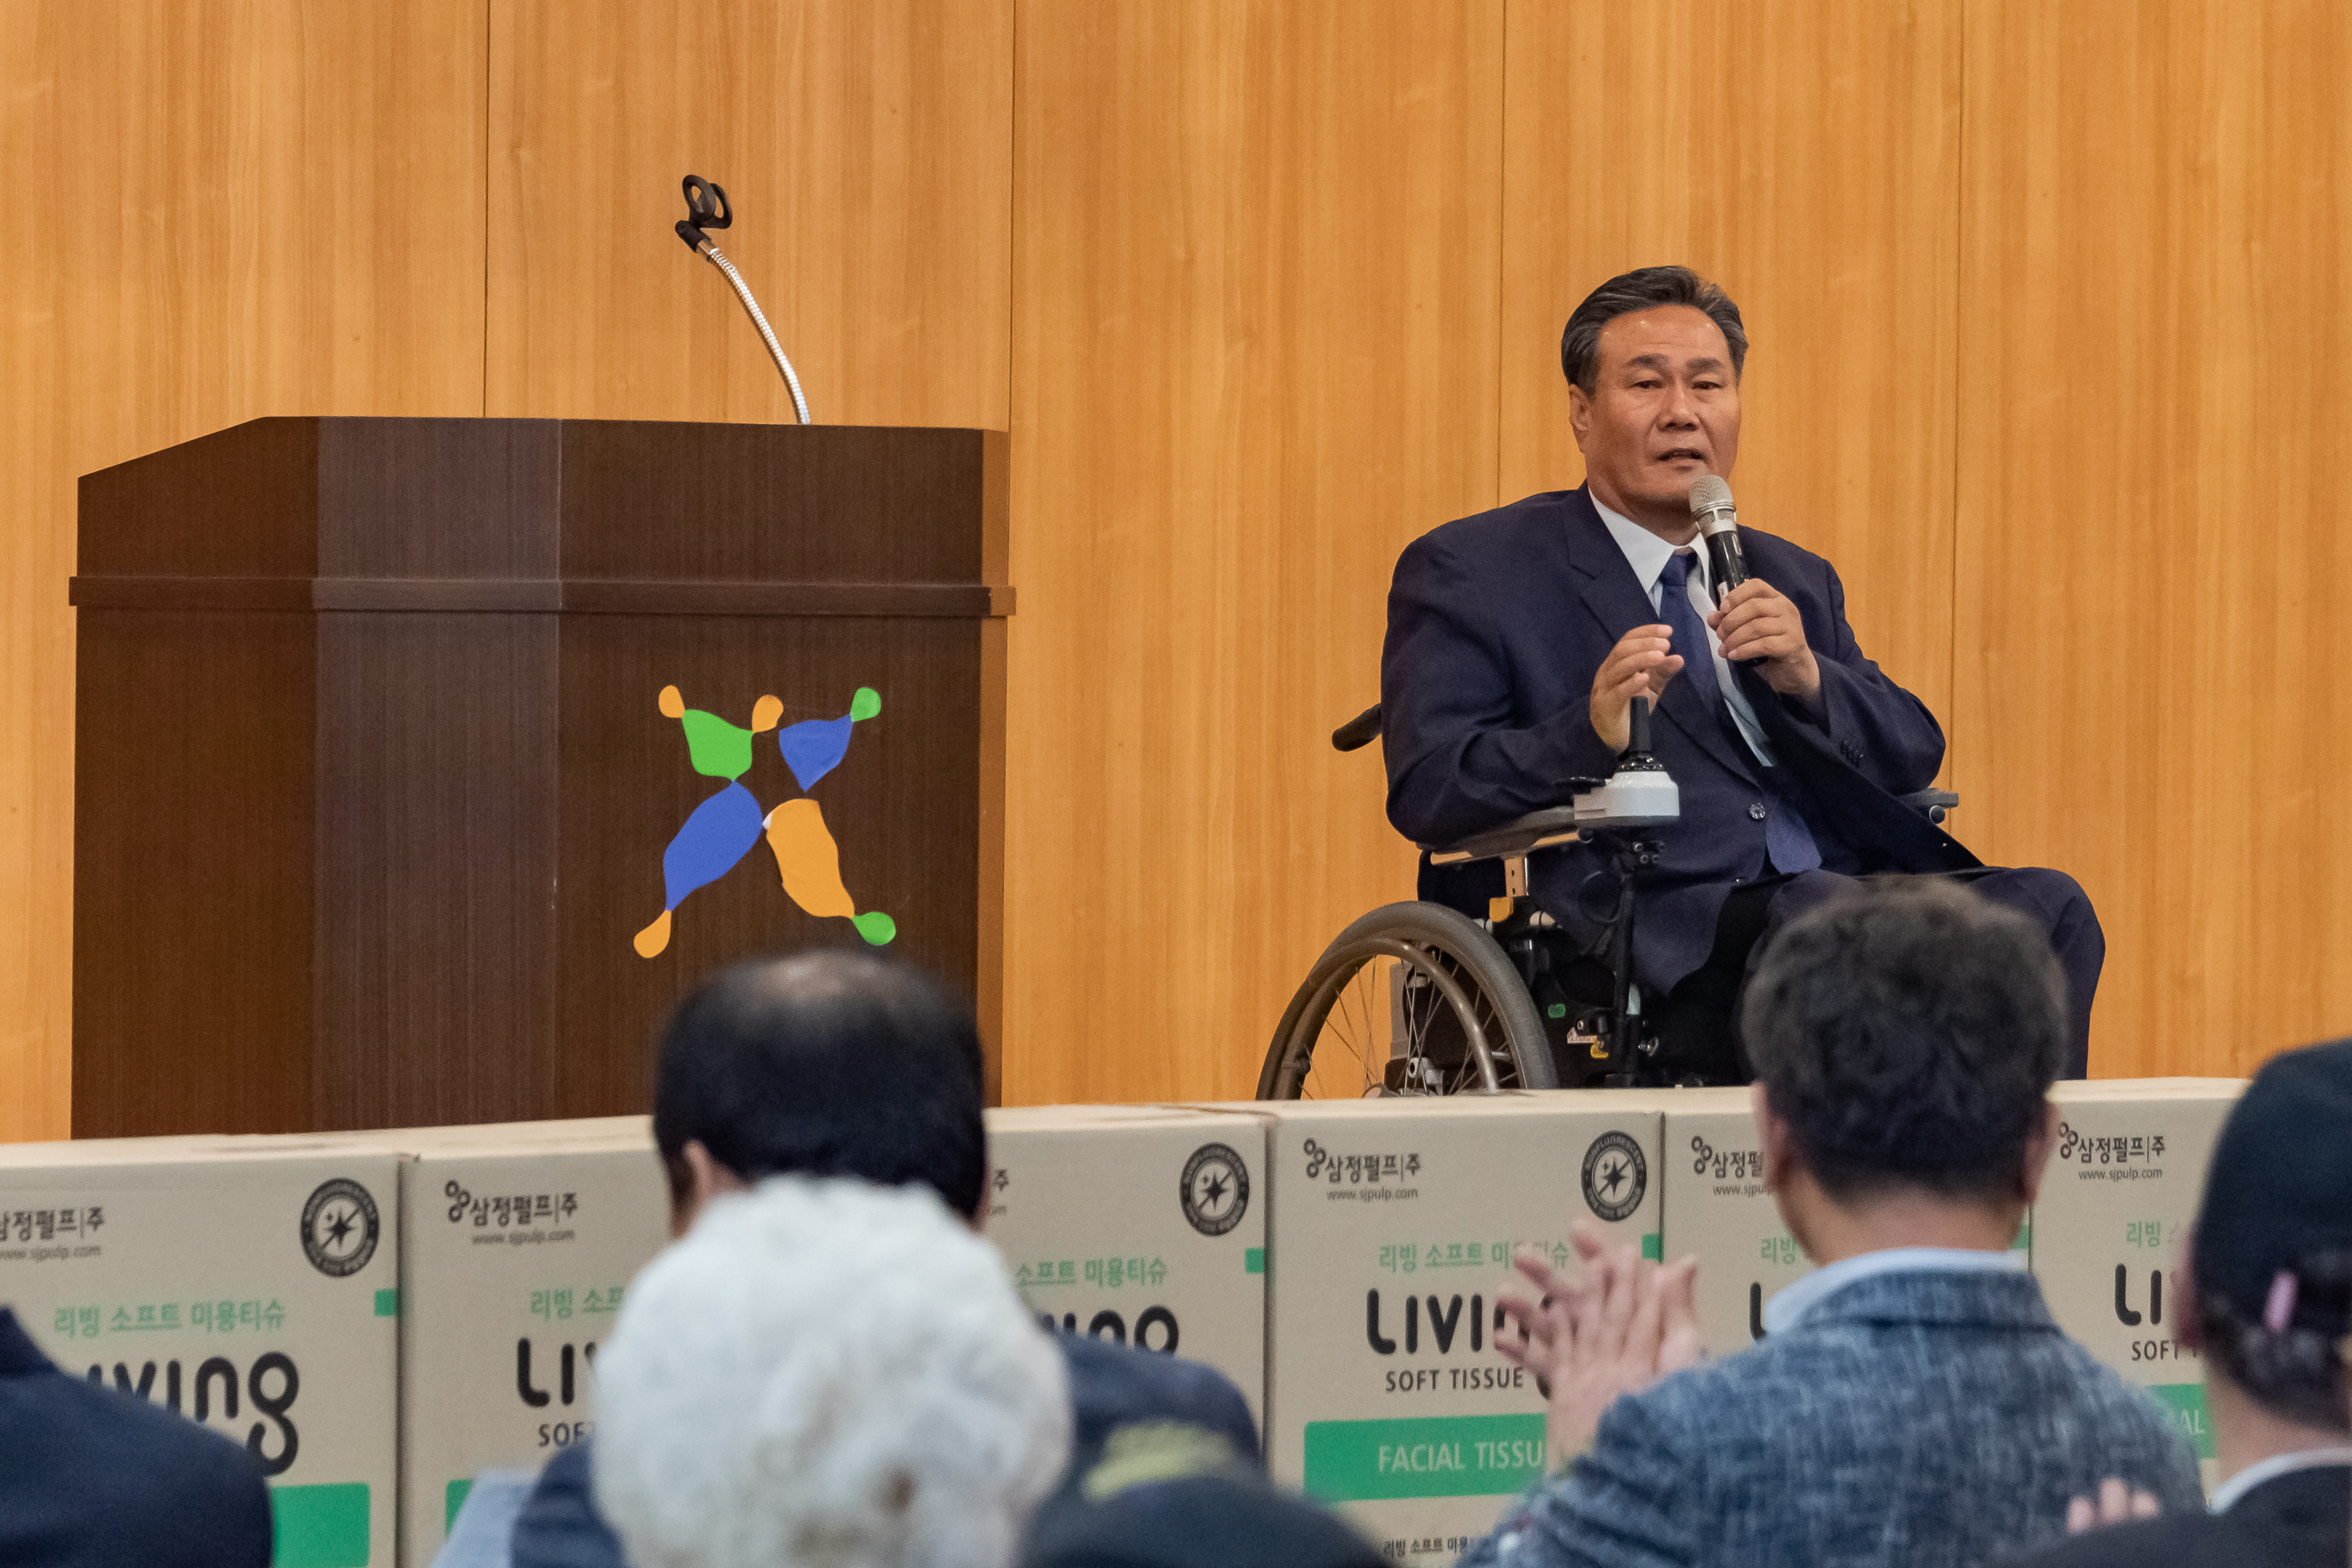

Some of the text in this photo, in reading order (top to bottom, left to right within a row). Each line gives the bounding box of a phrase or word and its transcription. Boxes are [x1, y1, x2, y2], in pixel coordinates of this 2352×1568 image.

[2079, 1167, 2163, 1182] www.sjpulp.com
[2126, 1221, 2160, 1248] 리빙
[1380, 1240, 1569, 1273] 리빙 소프트 미슈
[1761, 1237, 1797, 1265] 리빙
[1015, 1256, 1168, 1288] 소프트 미용티슈
[53, 1298, 286, 1338] 리빙 소프트 미용티슈
[530, 1286, 626, 1320] 리빙 소프
[1385, 1366, 1524, 1393] SOFT TISSUE
[538, 1422, 585, 1448] SOF
[1378, 1439, 1544, 1473] FACIAL TISSU
